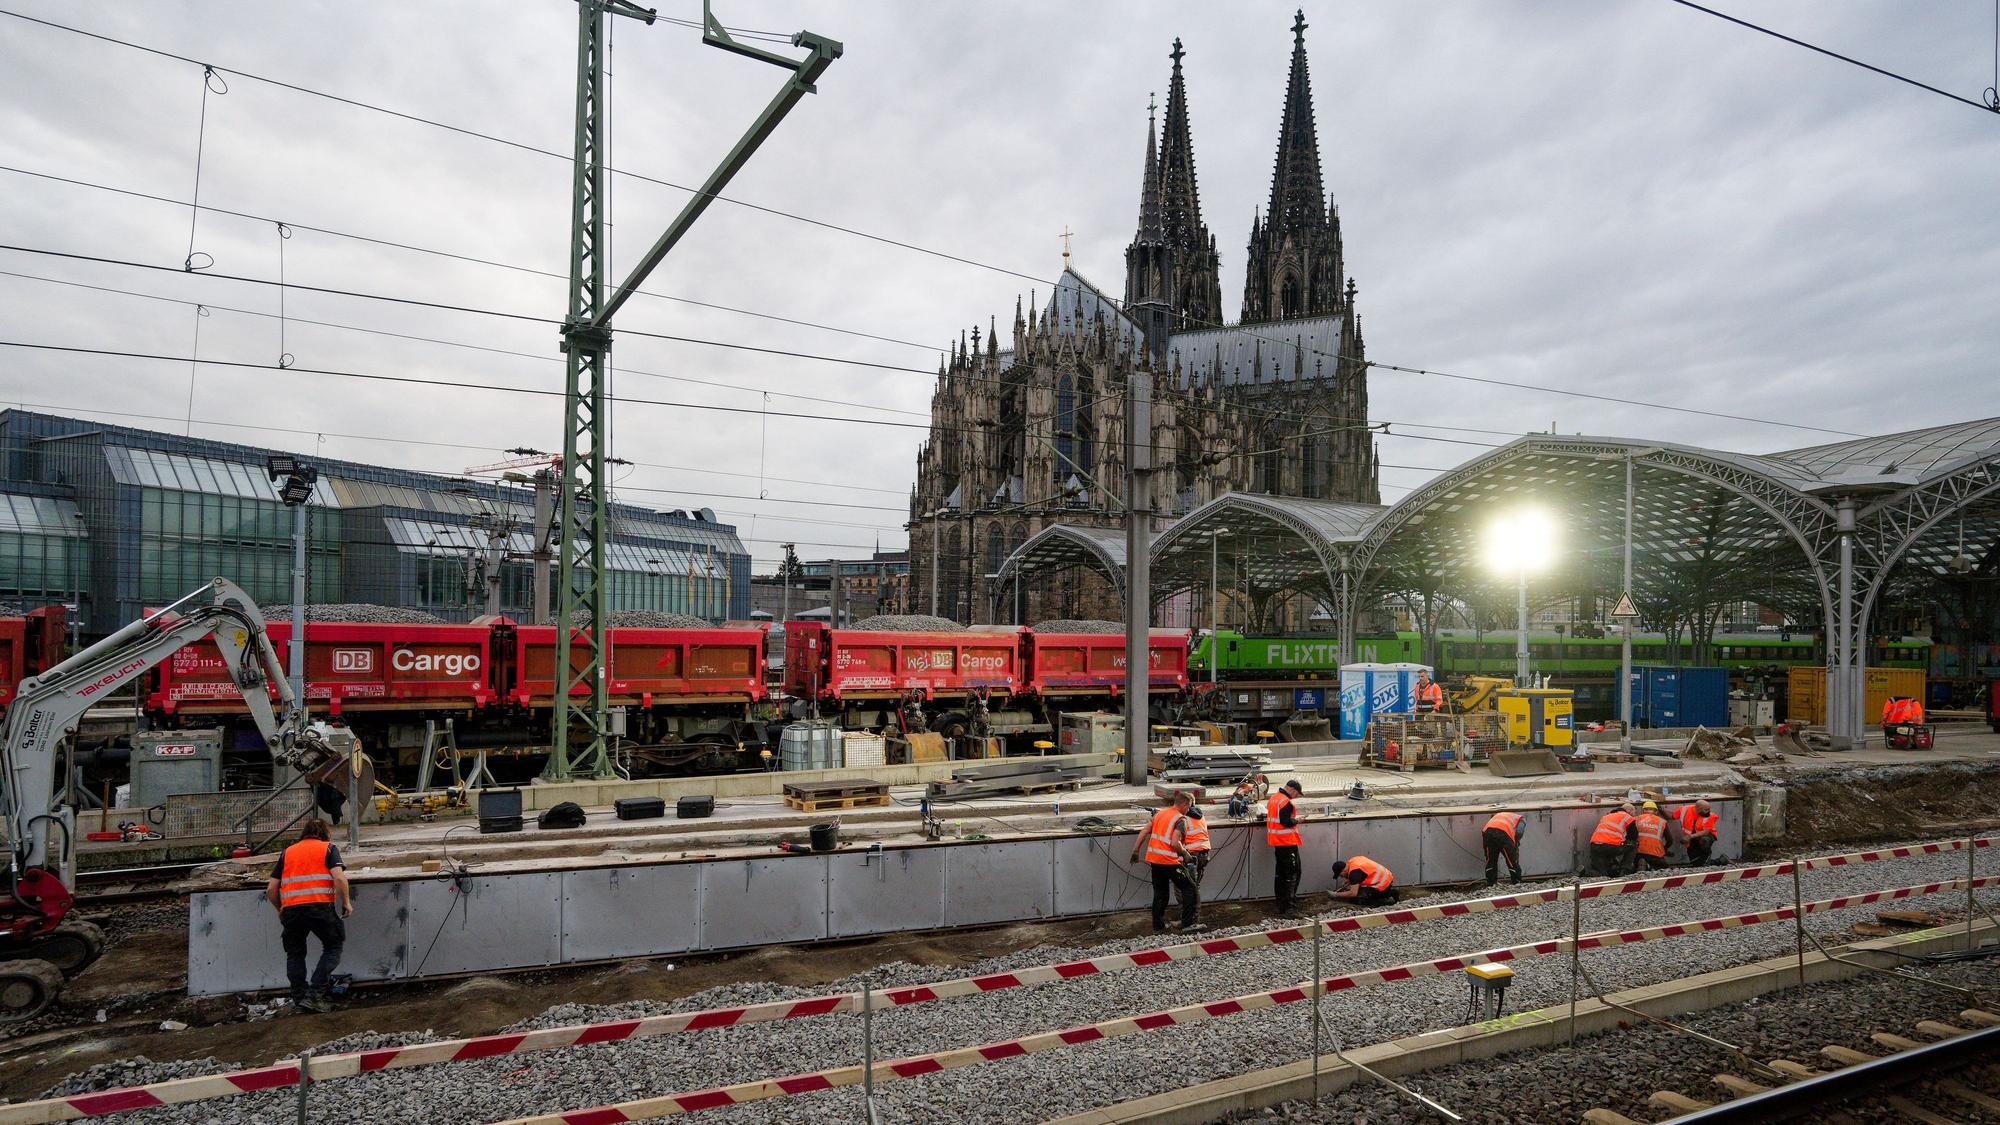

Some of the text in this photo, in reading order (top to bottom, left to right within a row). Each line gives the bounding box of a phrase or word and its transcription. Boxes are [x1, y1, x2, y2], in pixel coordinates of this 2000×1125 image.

[338, 649, 481, 675] DB Cargo
[961, 653, 1004, 670] Cargo
[1267, 644, 1377, 665] FLiXTRIN
[24, 709, 42, 738] Balter
[1757, 803, 1772, 824] 7
